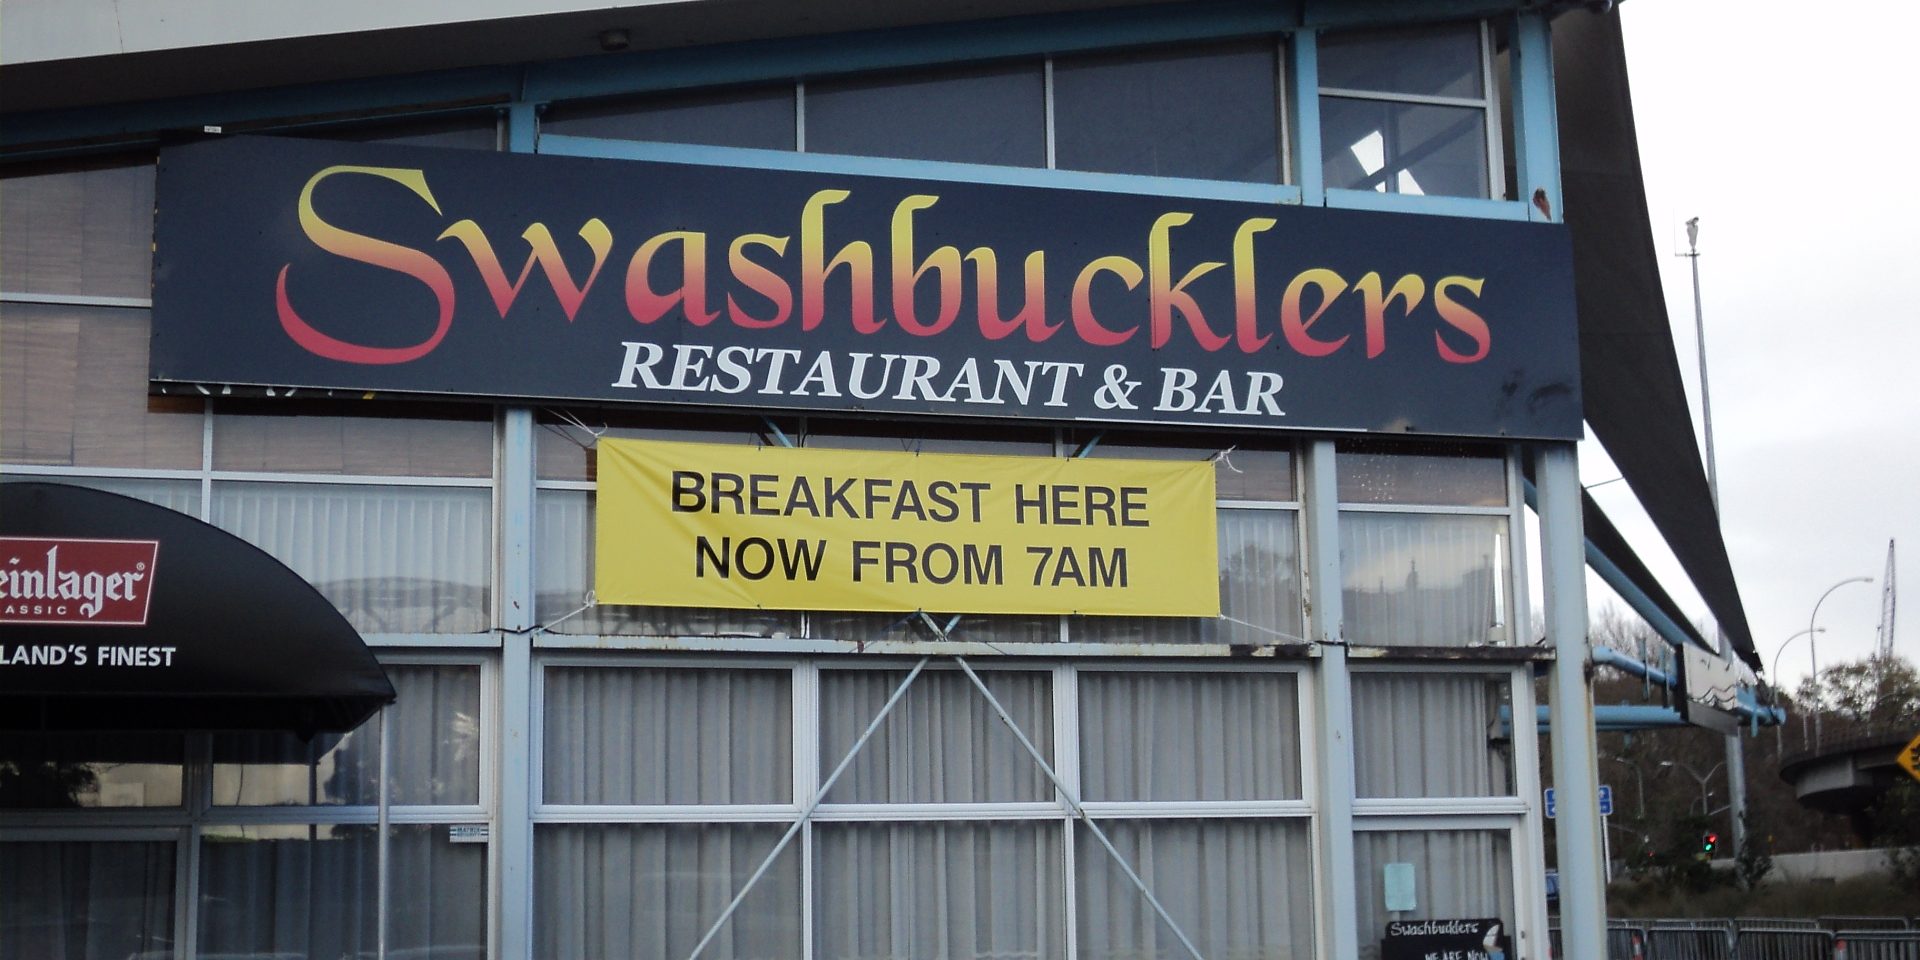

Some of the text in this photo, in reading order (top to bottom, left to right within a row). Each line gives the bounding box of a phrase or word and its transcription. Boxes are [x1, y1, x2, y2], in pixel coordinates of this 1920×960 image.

[276, 165, 1491, 365] Swashbucklers
[611, 341, 1285, 416] RESTAURANT & BAR
[671, 470, 1149, 527] BREAKFAST HERE
[695, 535, 1128, 588] NOW FROM 7AM
[98, 646, 176, 666] FINEST
